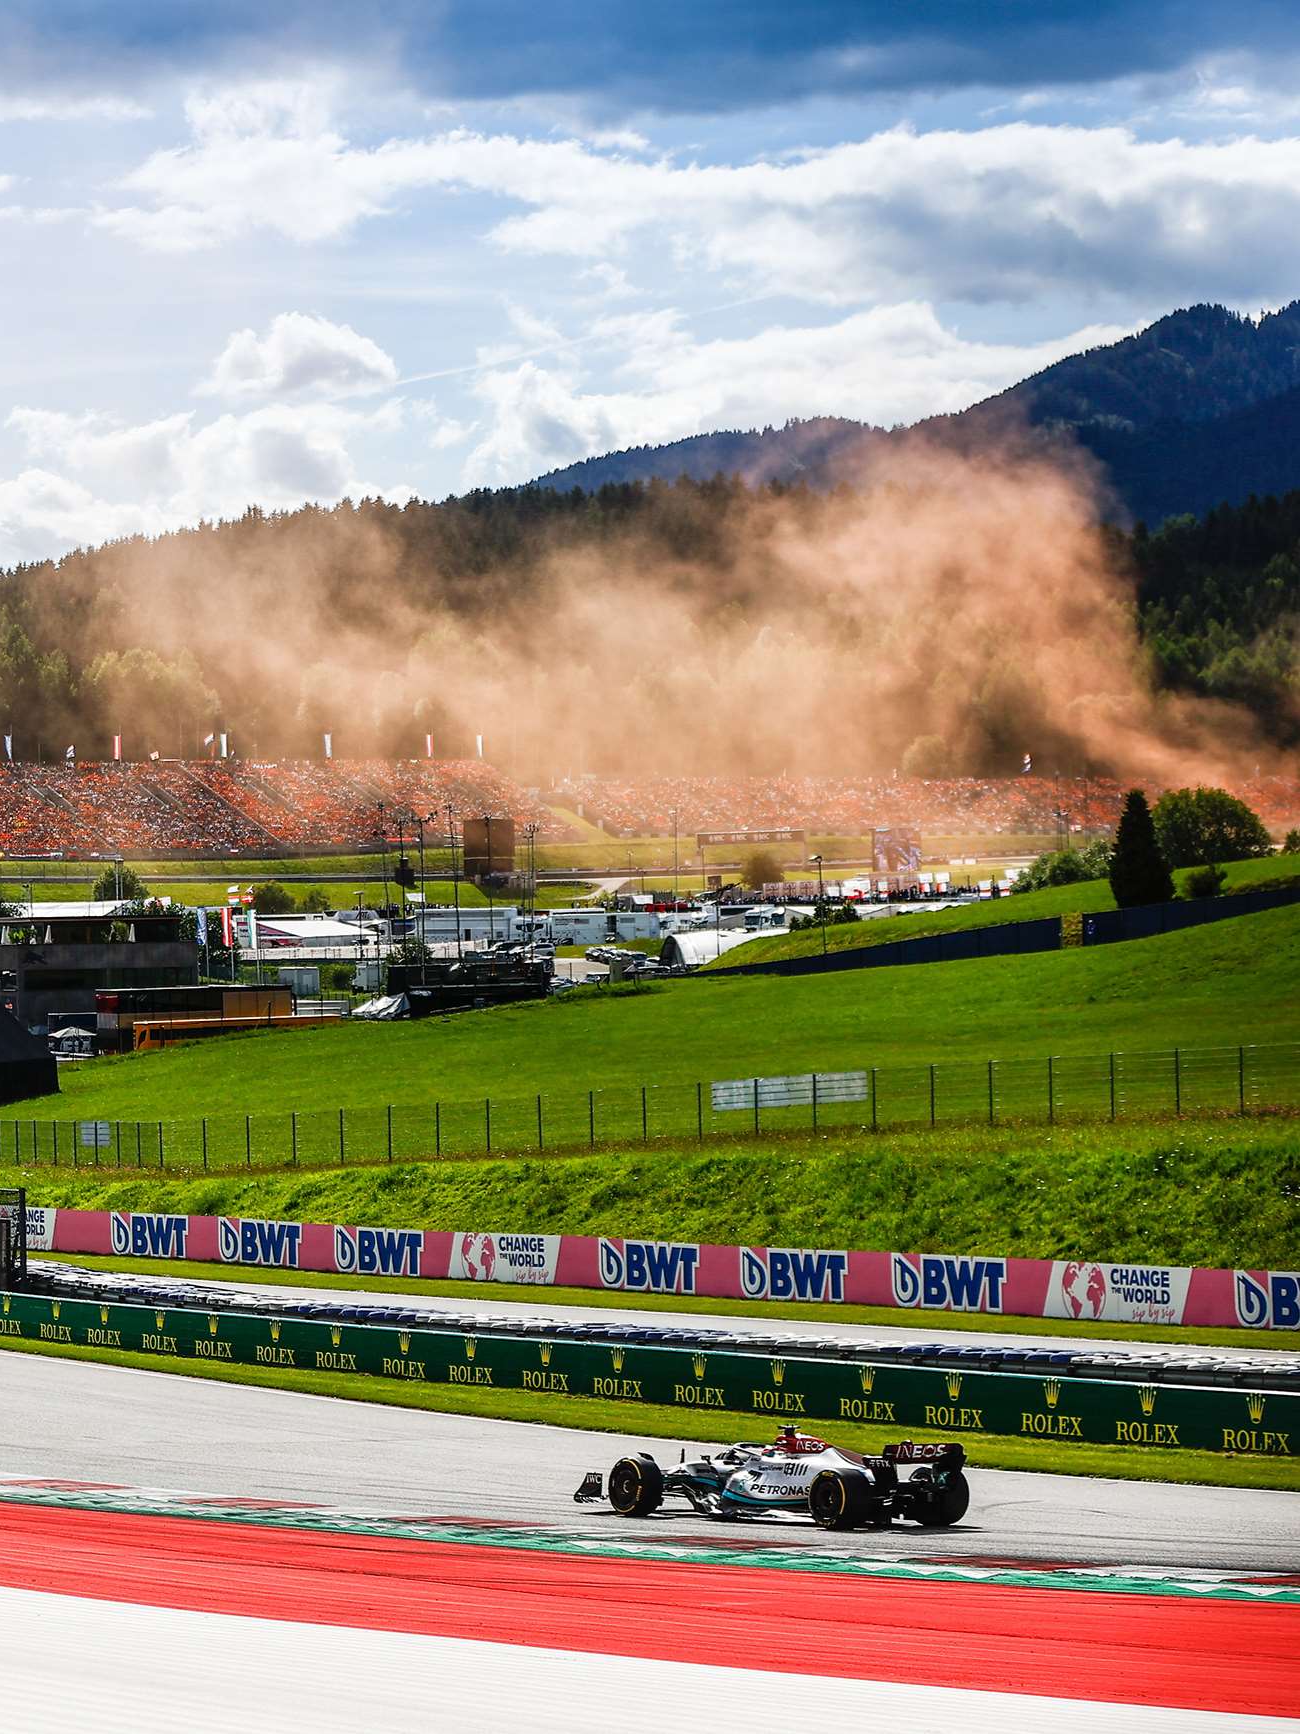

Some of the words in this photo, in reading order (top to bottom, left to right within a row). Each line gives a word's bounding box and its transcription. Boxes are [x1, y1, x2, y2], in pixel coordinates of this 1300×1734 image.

[131, 1215, 188, 1258] BWT
[240, 1219, 301, 1267] BWT
[499, 1236, 545, 1252] CHANGE
[357, 1227, 423, 1276] BWT
[508, 1253, 546, 1268] WORLD
[625, 1243, 698, 1294] BWT
[770, 1251, 847, 1300] BWT
[1110, 1268, 1170, 1288] CHANGE
[923, 1259, 1005, 1311] BWT
[1122, 1288, 1171, 1305] WORLD
[40, 1323, 72, 1342] ROLEX
[87, 1328, 121, 1347] ROLEX
[142, 1333, 177, 1353] ROLEX
[195, 1340, 232, 1358] ROLEX
[256, 1346, 296, 1366] ROLEX
[315, 1351, 357, 1371] ROLEX
[383, 1358, 426, 1379] ROLEX
[449, 1364, 494, 1385] ROLEX
[522, 1370, 569, 1392] ROLEX
[593, 1377, 643, 1399] ROLEX
[674, 1384, 725, 1407] ROLEX
[752, 1390, 806, 1413] ROLEX
[839, 1398, 896, 1422] ROLEX
[925, 1405, 984, 1429] ROLEX
[1021, 1412, 1084, 1437] ROLEX
[1115, 1421, 1181, 1445] ROLEX
[1222, 1428, 1291, 1453] ROLEX
[795, 1440, 826, 1451] INEOS
[895, 1444, 948, 1459] INEOS
[586, 1474, 602, 1484] IWC
[750, 1483, 810, 1496] PETRONAS
